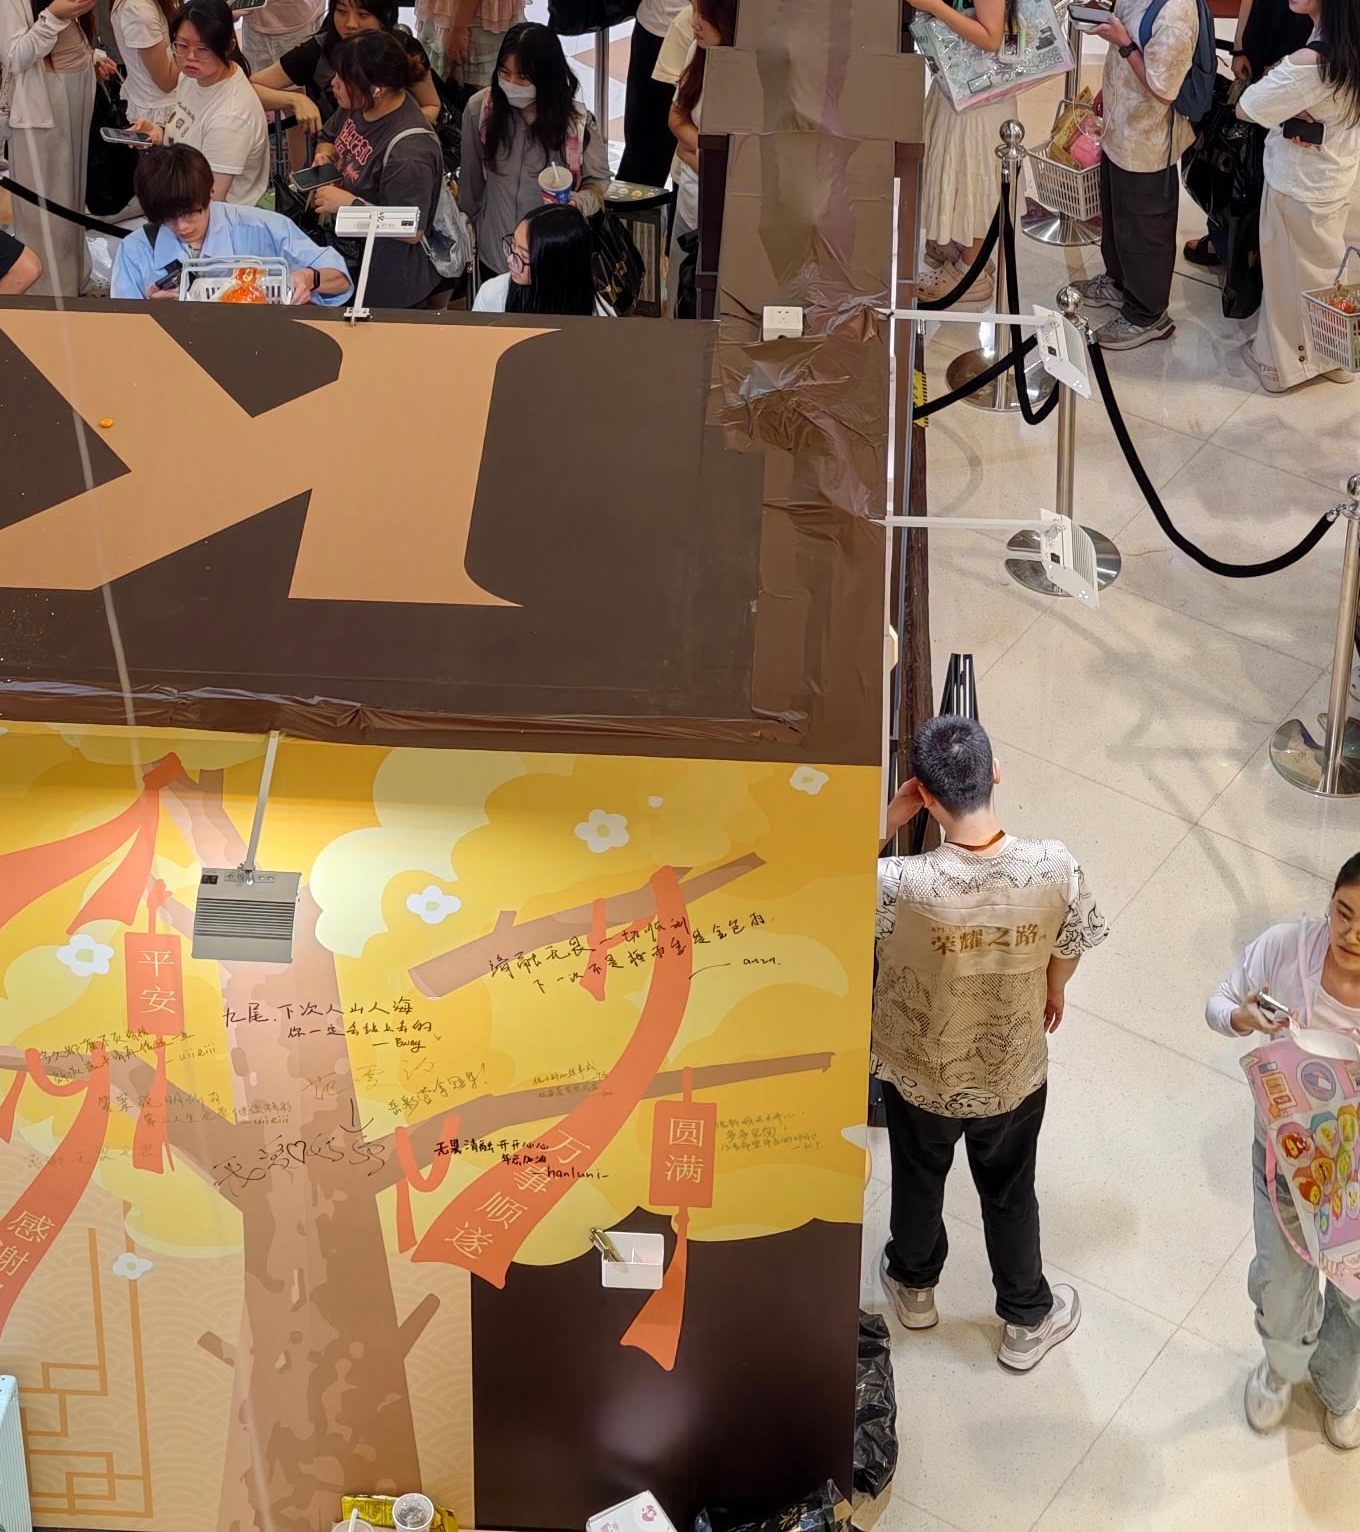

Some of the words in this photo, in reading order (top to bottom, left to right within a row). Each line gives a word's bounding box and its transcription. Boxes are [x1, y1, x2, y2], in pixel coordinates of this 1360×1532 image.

[929, 924, 1039, 956] 荣耀之路
[136, 948, 177, 1014] 平安
[664, 1117, 705, 1185] 圆满
[443, 1129, 593, 1260] 万事顺遂
